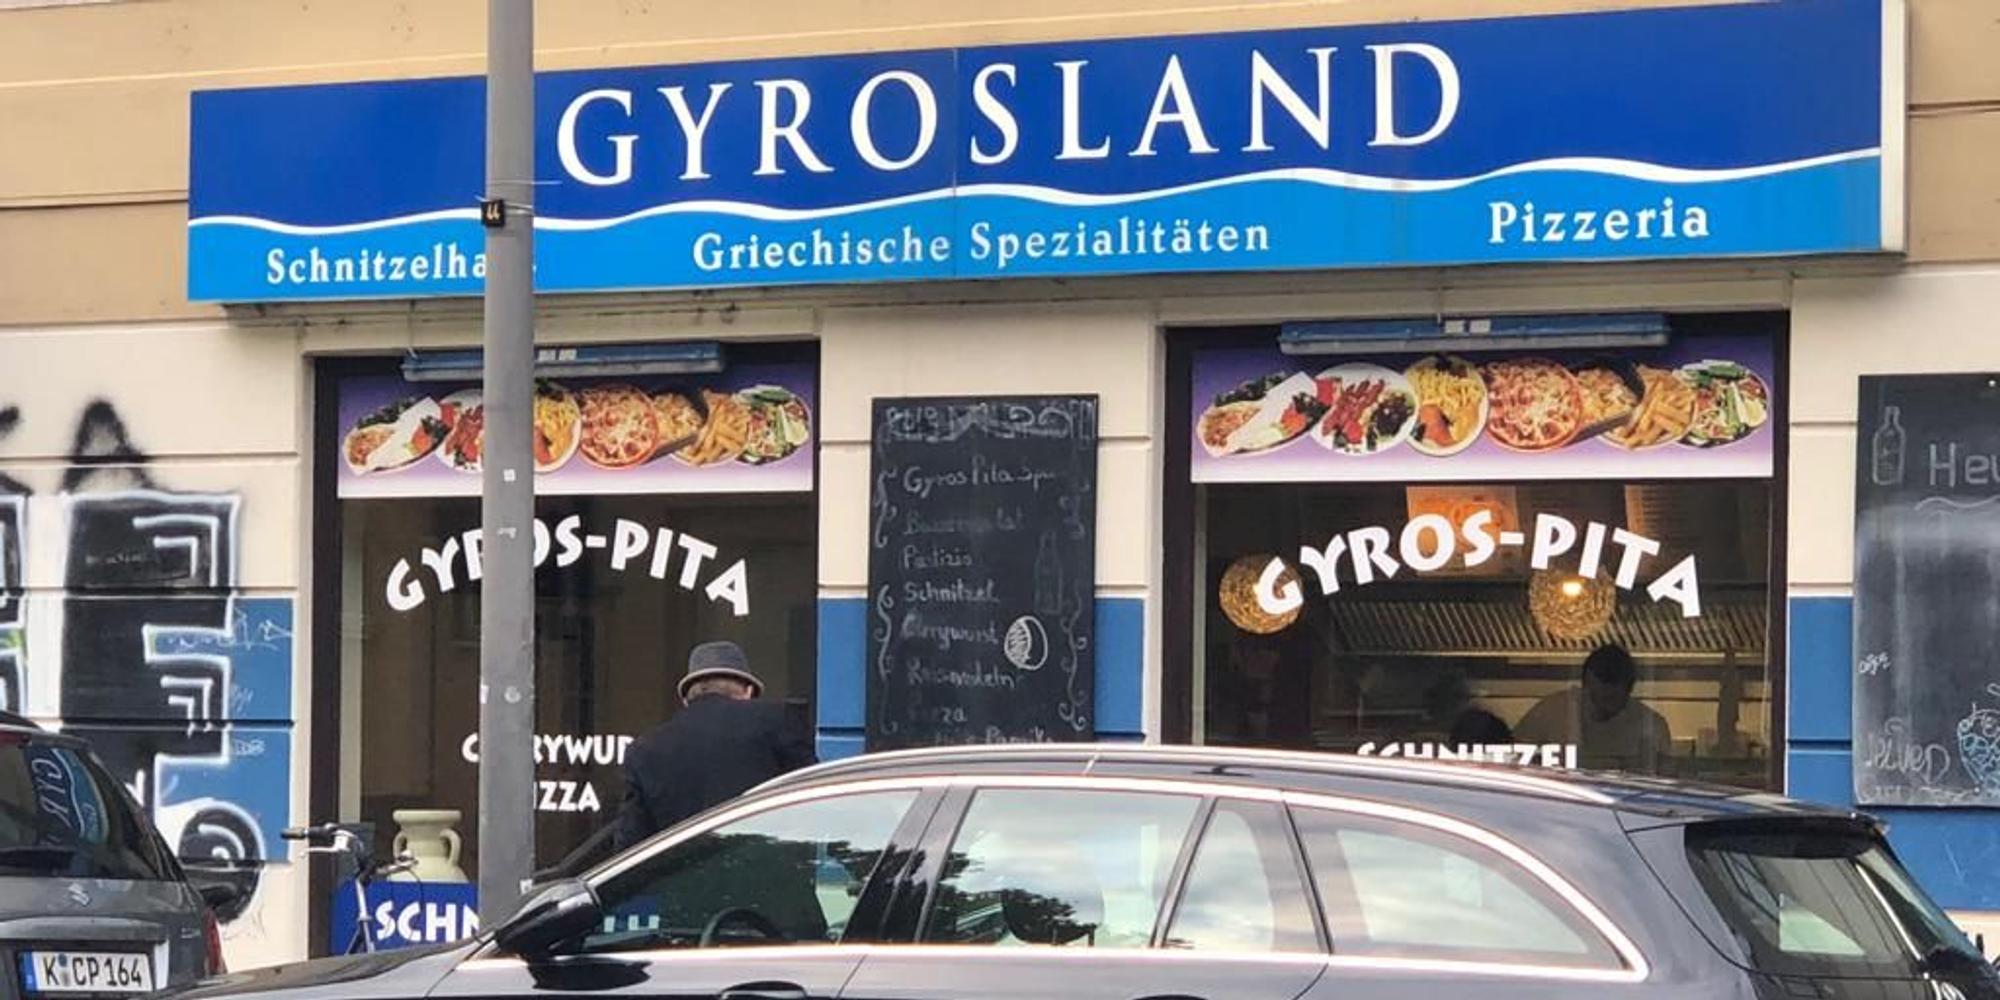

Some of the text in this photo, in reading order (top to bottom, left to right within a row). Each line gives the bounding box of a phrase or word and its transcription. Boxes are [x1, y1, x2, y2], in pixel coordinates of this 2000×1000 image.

[557, 42, 1462, 187] GYROSLAND
[1489, 197, 1709, 244] Pizzeria
[267, 244, 537, 284] Schnitzelha
[693, 217, 1270, 271] Griechische Spezialitäten
[903, 466, 968, 498] Gyros
[1254, 511, 1701, 617] GYROS-PITA
[904, 579, 1000, 604] Schnitzel
[533, 780, 601, 812] ZZA
[43, 956, 142, 987] K CP 164
